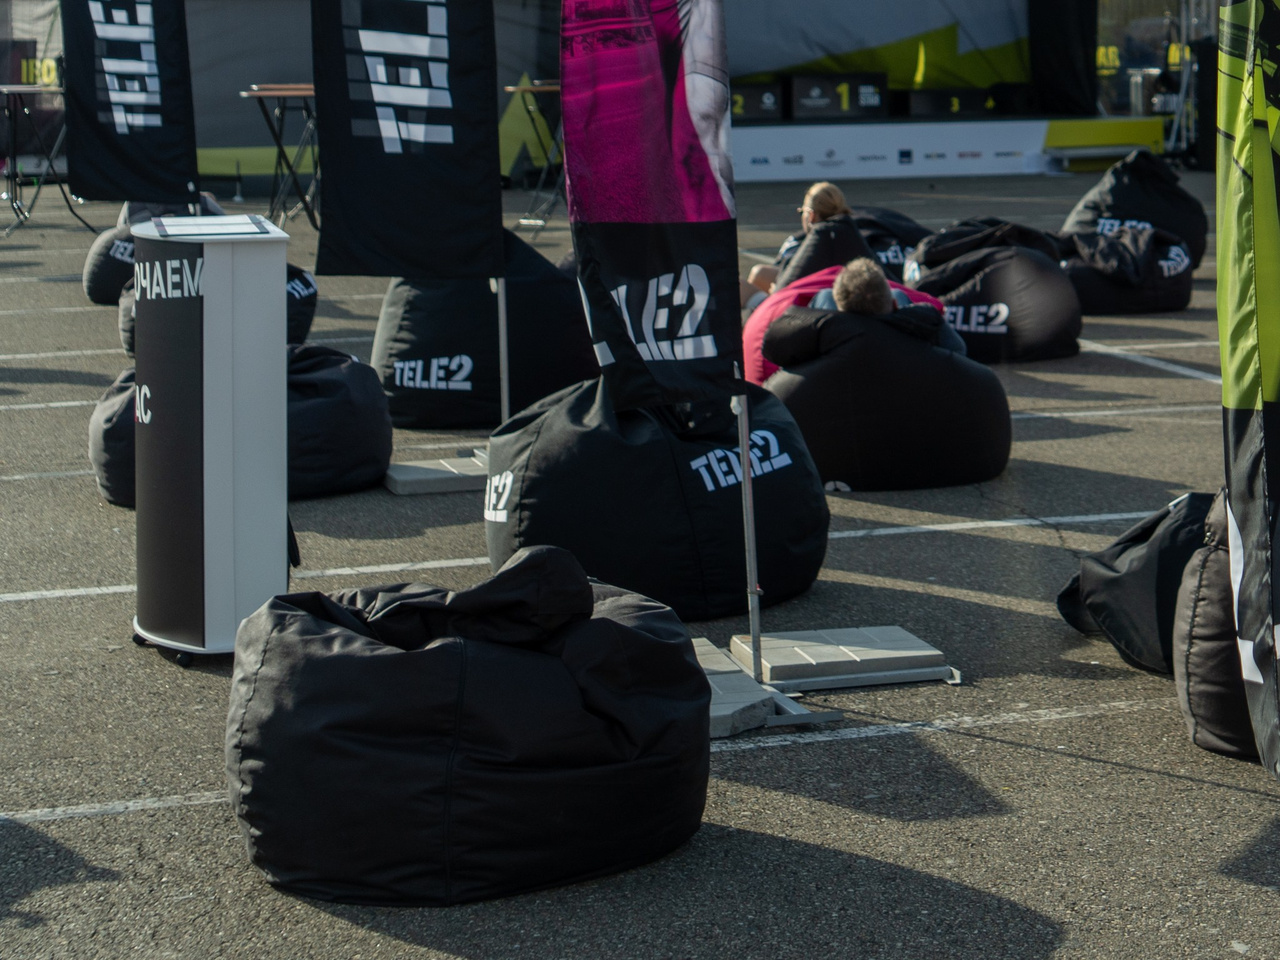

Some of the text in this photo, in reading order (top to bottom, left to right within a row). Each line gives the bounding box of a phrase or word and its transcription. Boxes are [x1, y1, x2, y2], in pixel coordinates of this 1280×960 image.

[836, 82, 849, 111] 1
[950, 97, 959, 113] 3
[393, 355, 473, 390] TELE2
[690, 429, 792, 491] TELE2
